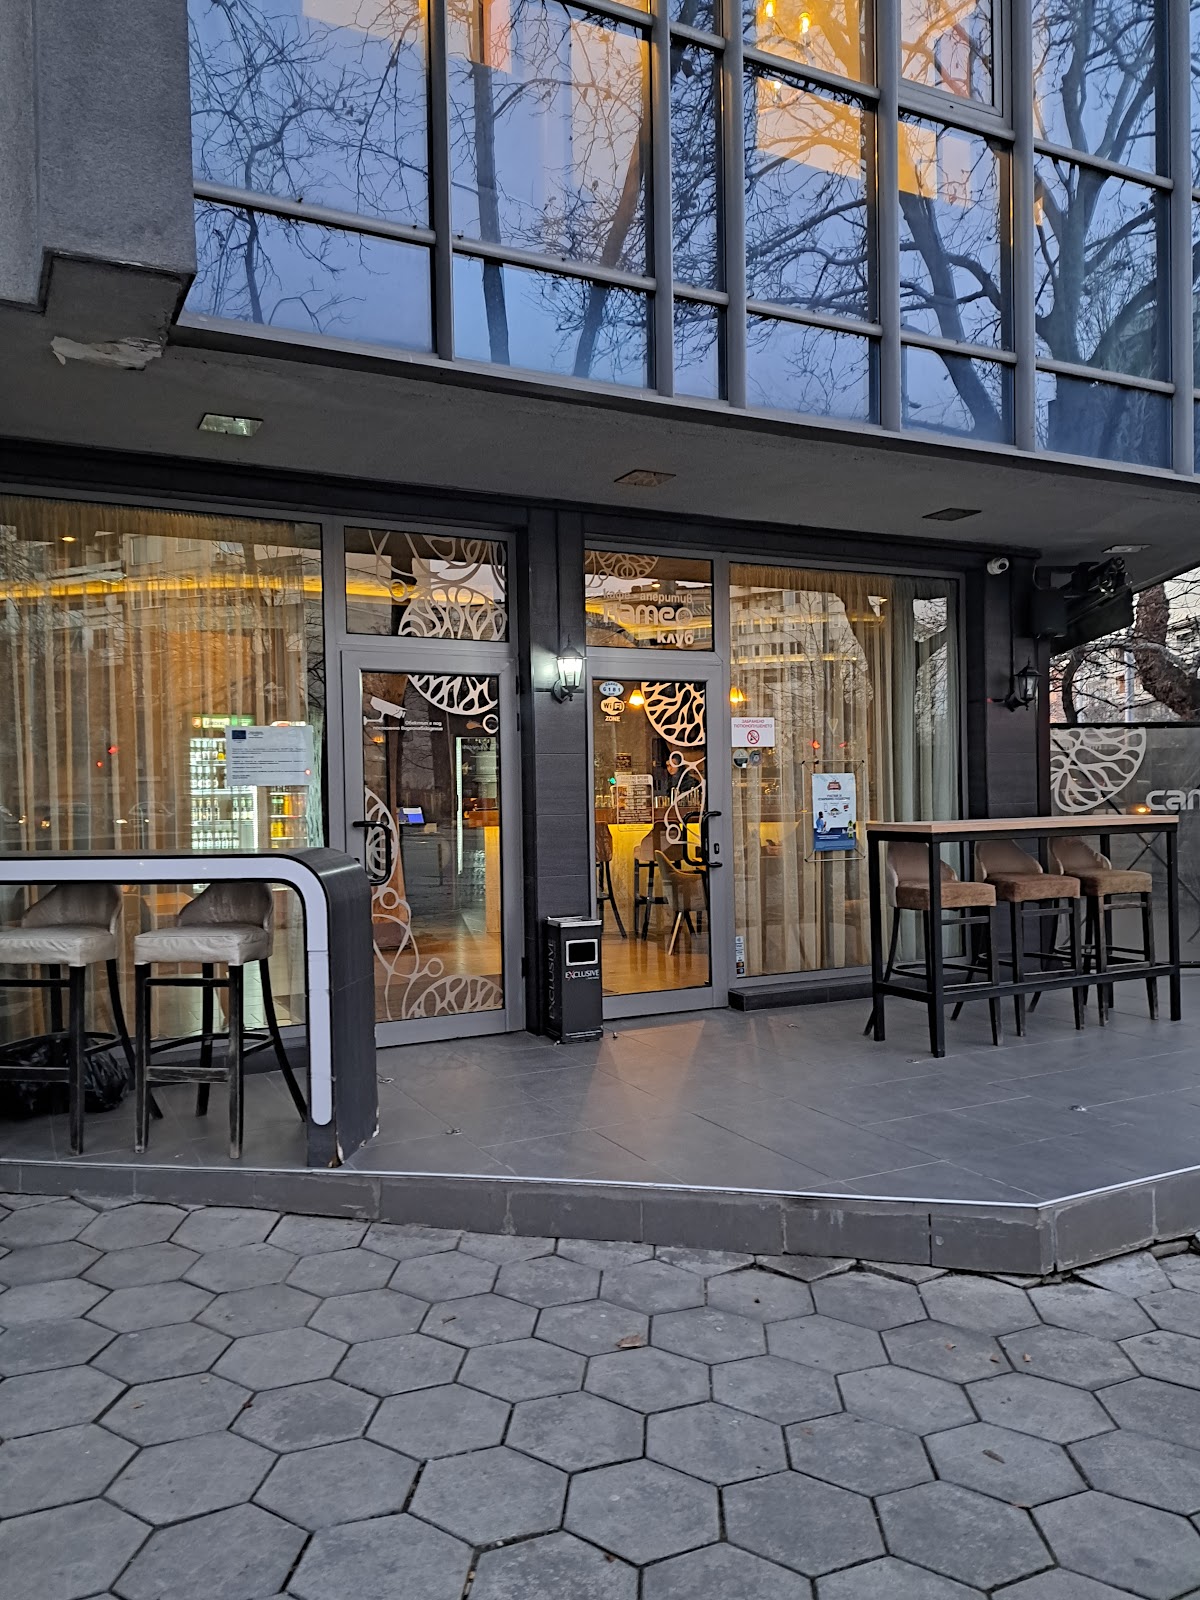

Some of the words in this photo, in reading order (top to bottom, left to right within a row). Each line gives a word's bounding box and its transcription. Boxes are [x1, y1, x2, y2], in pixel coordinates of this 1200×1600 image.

[640, 593, 693, 604] аперитив
[657, 631, 694, 648] клуб
[565, 969, 599, 980] EXCLUSIVE
